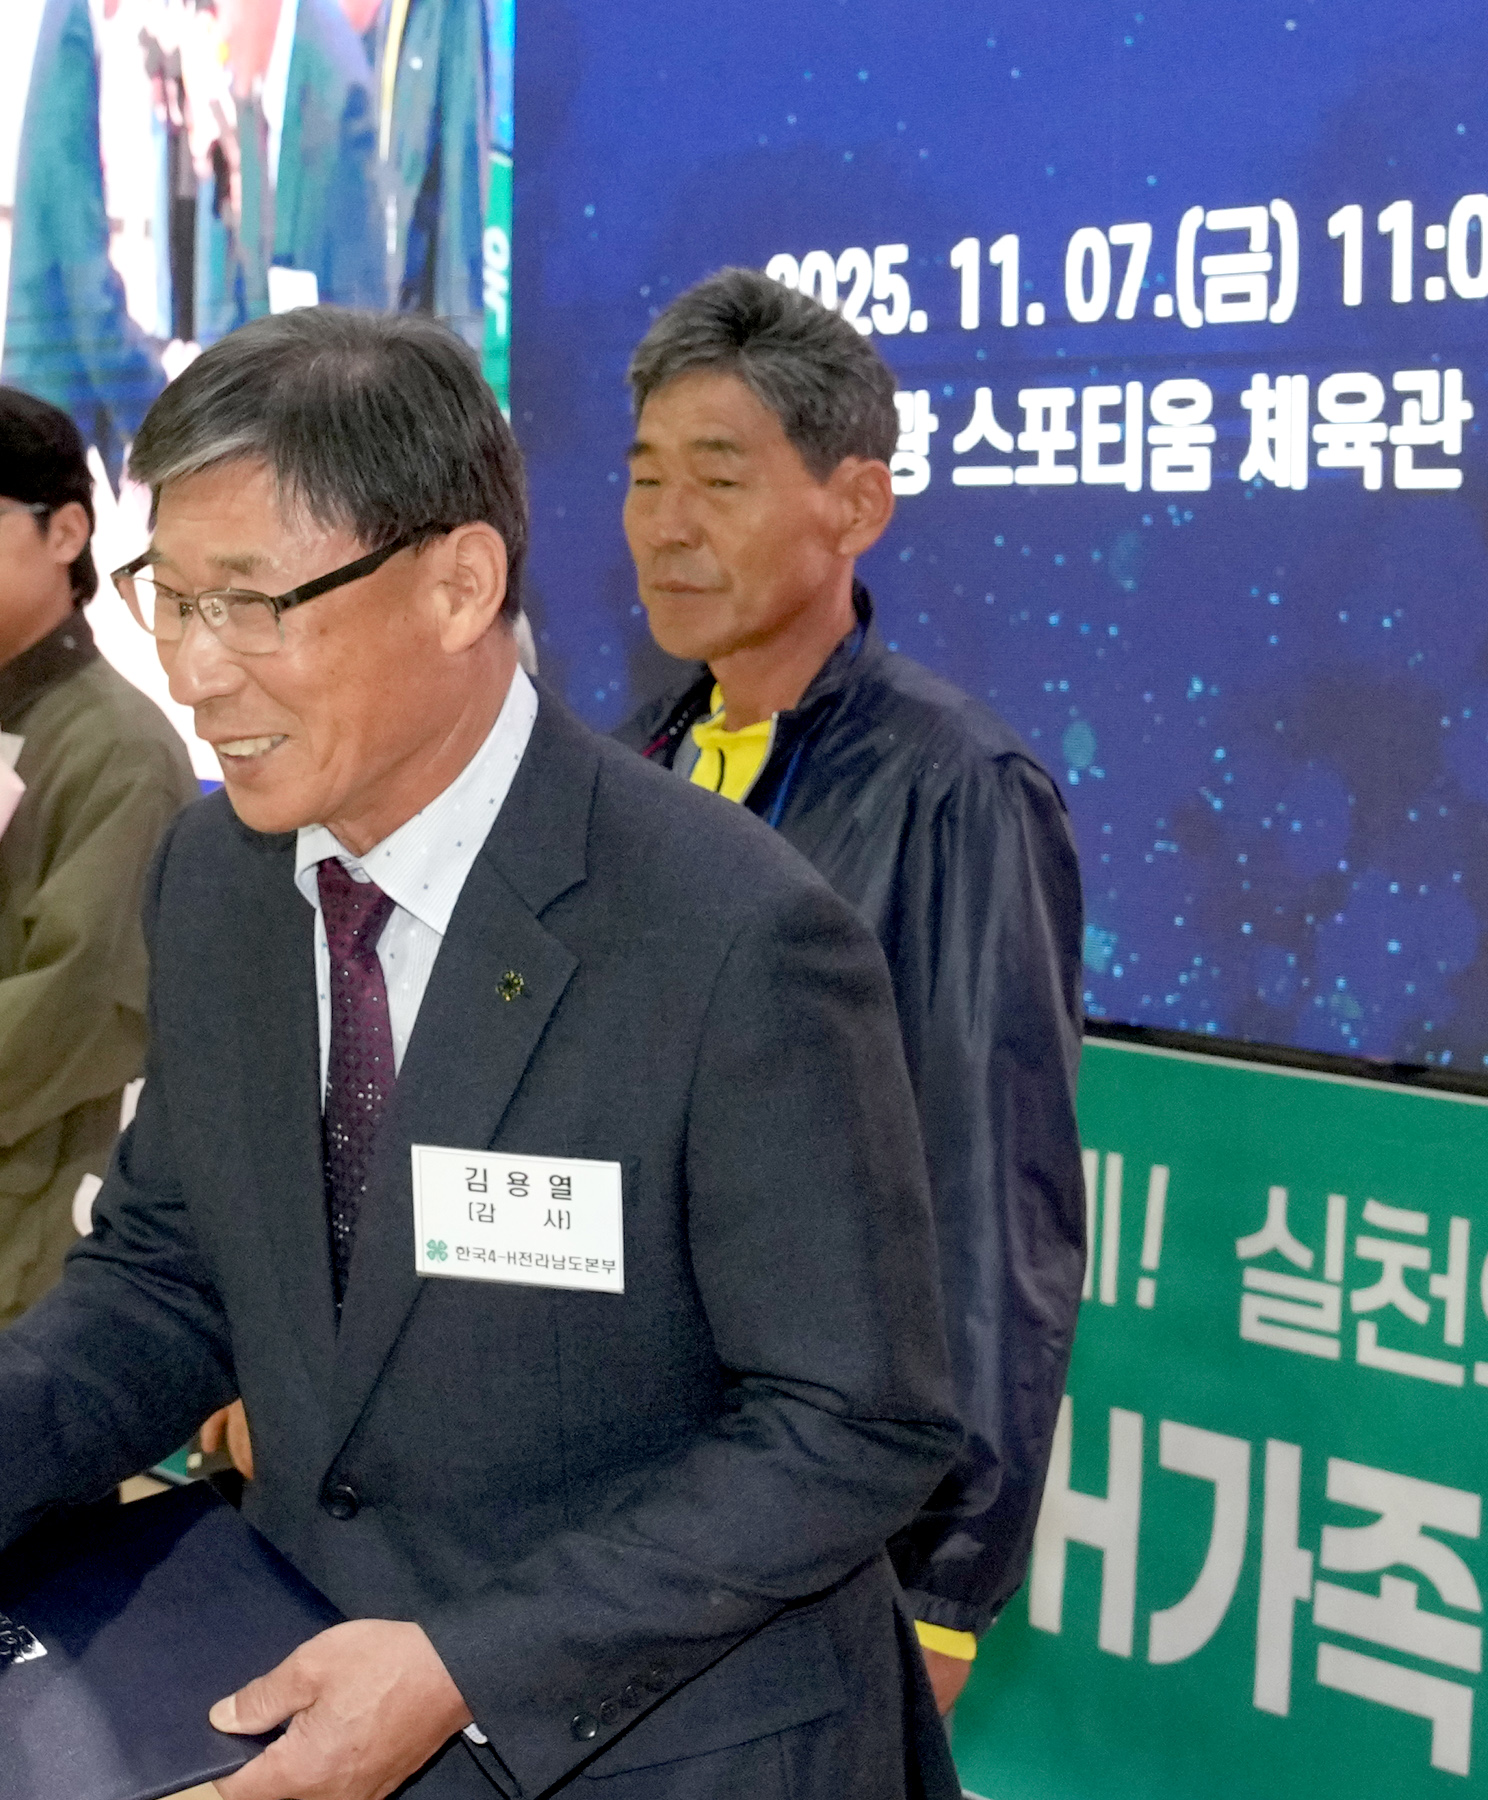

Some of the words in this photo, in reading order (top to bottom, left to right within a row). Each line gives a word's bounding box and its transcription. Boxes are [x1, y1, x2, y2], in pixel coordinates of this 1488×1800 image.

[950, 233, 1045, 329] 11.
[1065, 198, 1300, 329] 07.(금)
[952, 378, 1217, 492] 스포티움
[1238, 368, 1474, 491] 체육관
[455, 1246, 616, 1275] 한국4-H전라남도본부
[1235, 1185, 1488, 1388] 실천
